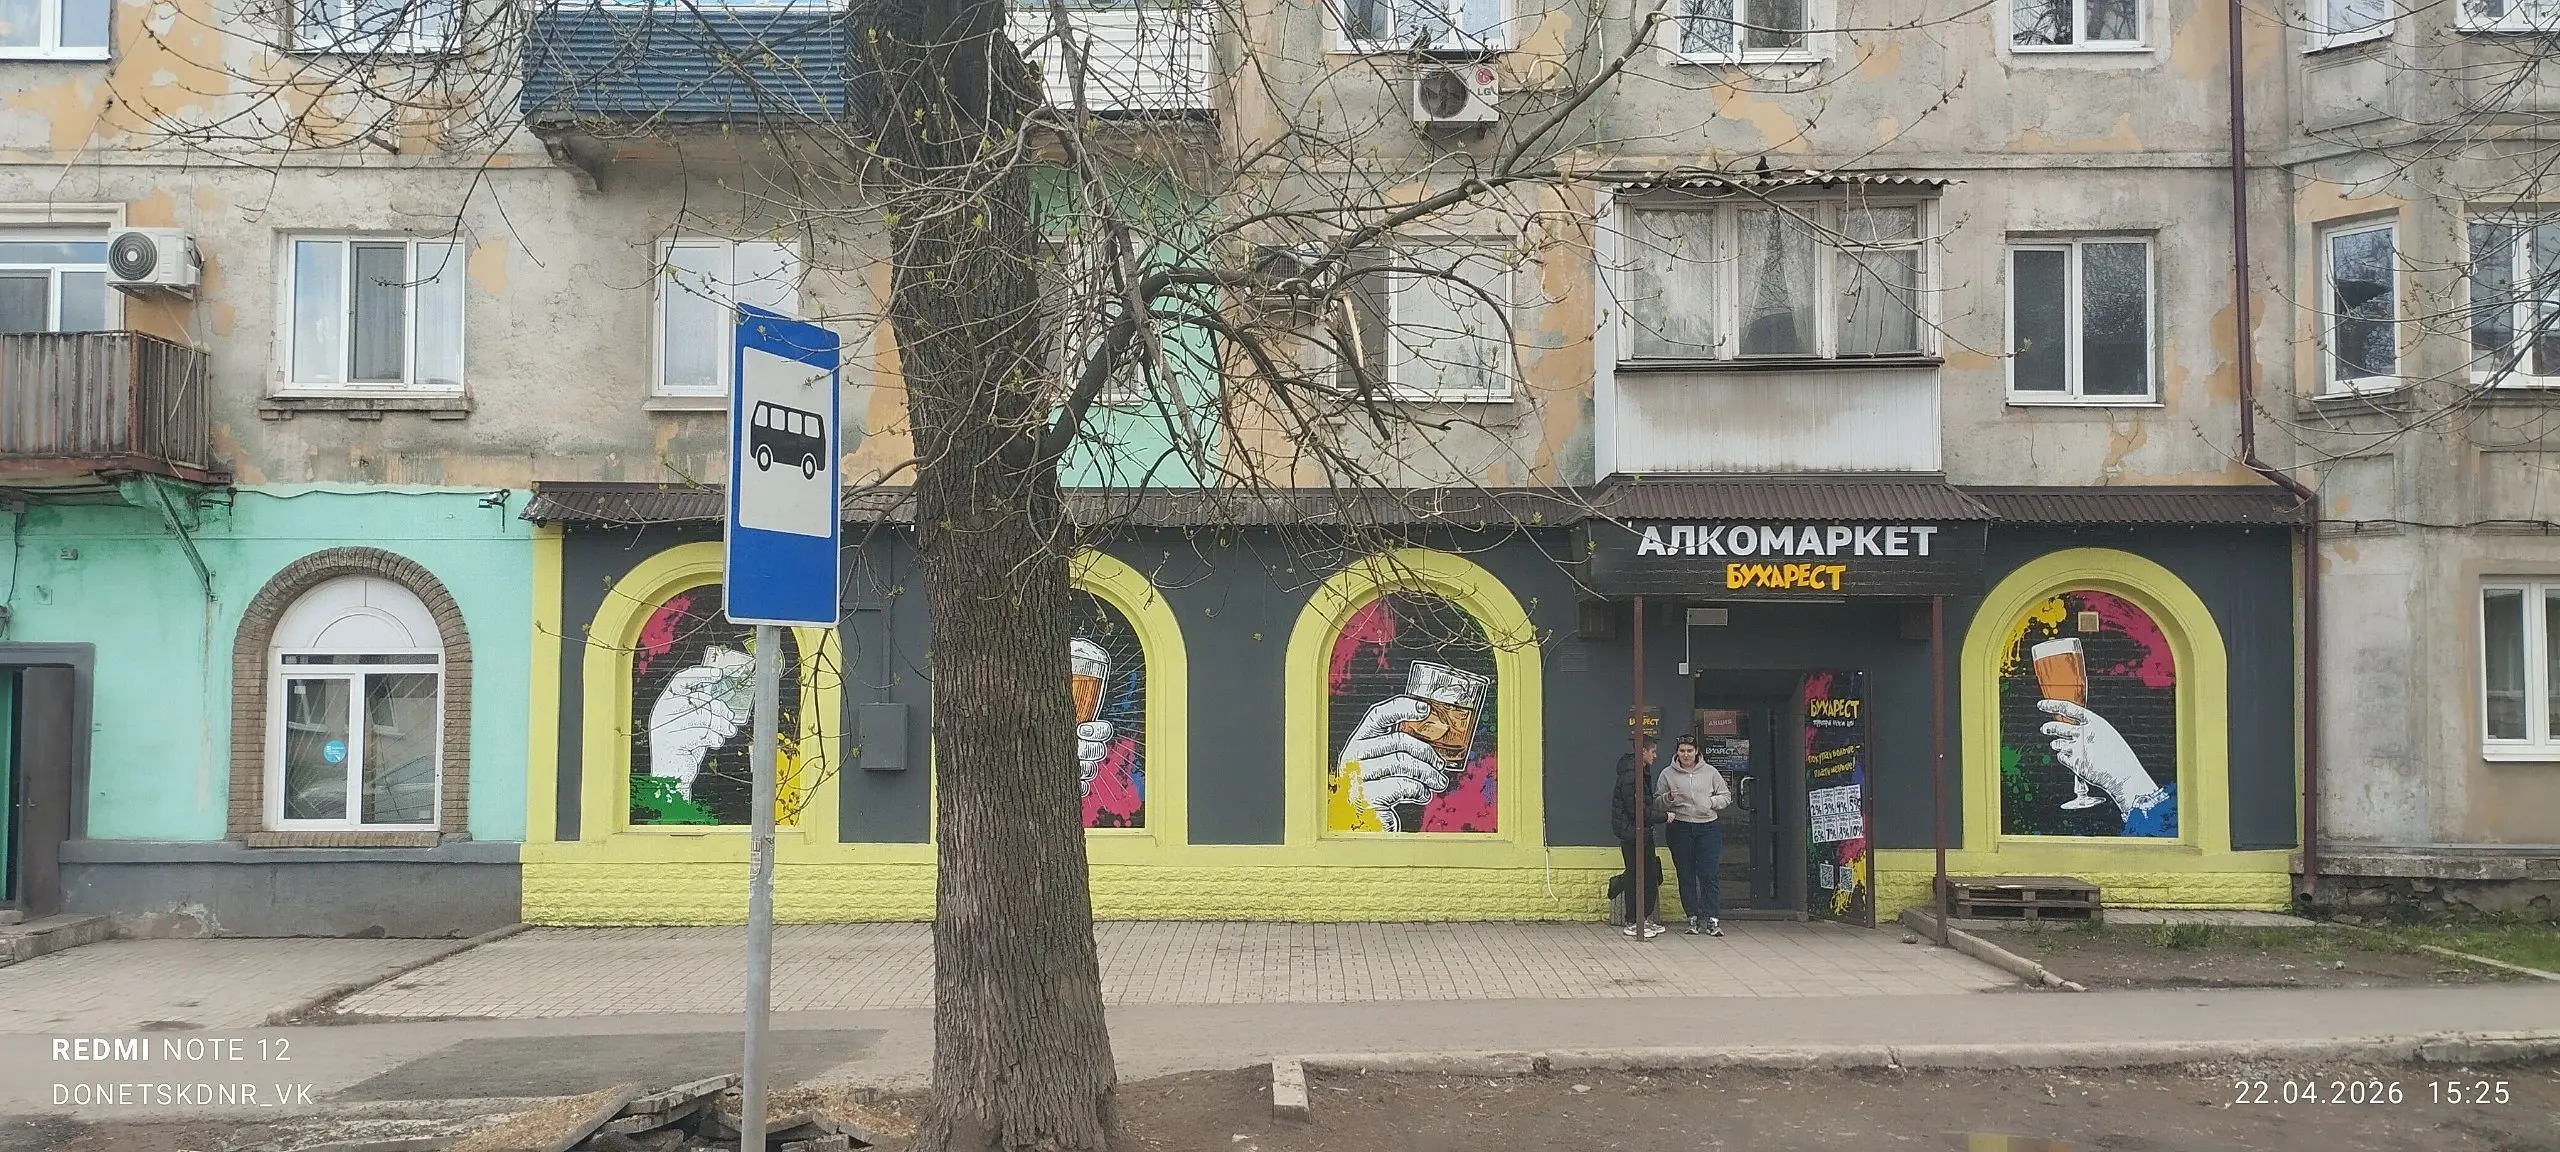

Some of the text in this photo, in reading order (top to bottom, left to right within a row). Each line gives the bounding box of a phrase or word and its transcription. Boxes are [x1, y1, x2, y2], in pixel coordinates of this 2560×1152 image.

[1477, 87, 1491, 96] LG
[1637, 525, 1938, 556] АЛКОМАРКЕТ
[1726, 563, 1847, 591] БУХАРЕСТ
[1810, 699, 1860, 719] БУХАРЕСТ
[1823, 802, 1835, 814] 3%
[1836, 801, 1848, 813] 4%
[1826, 828, 1837, 840] 7%
